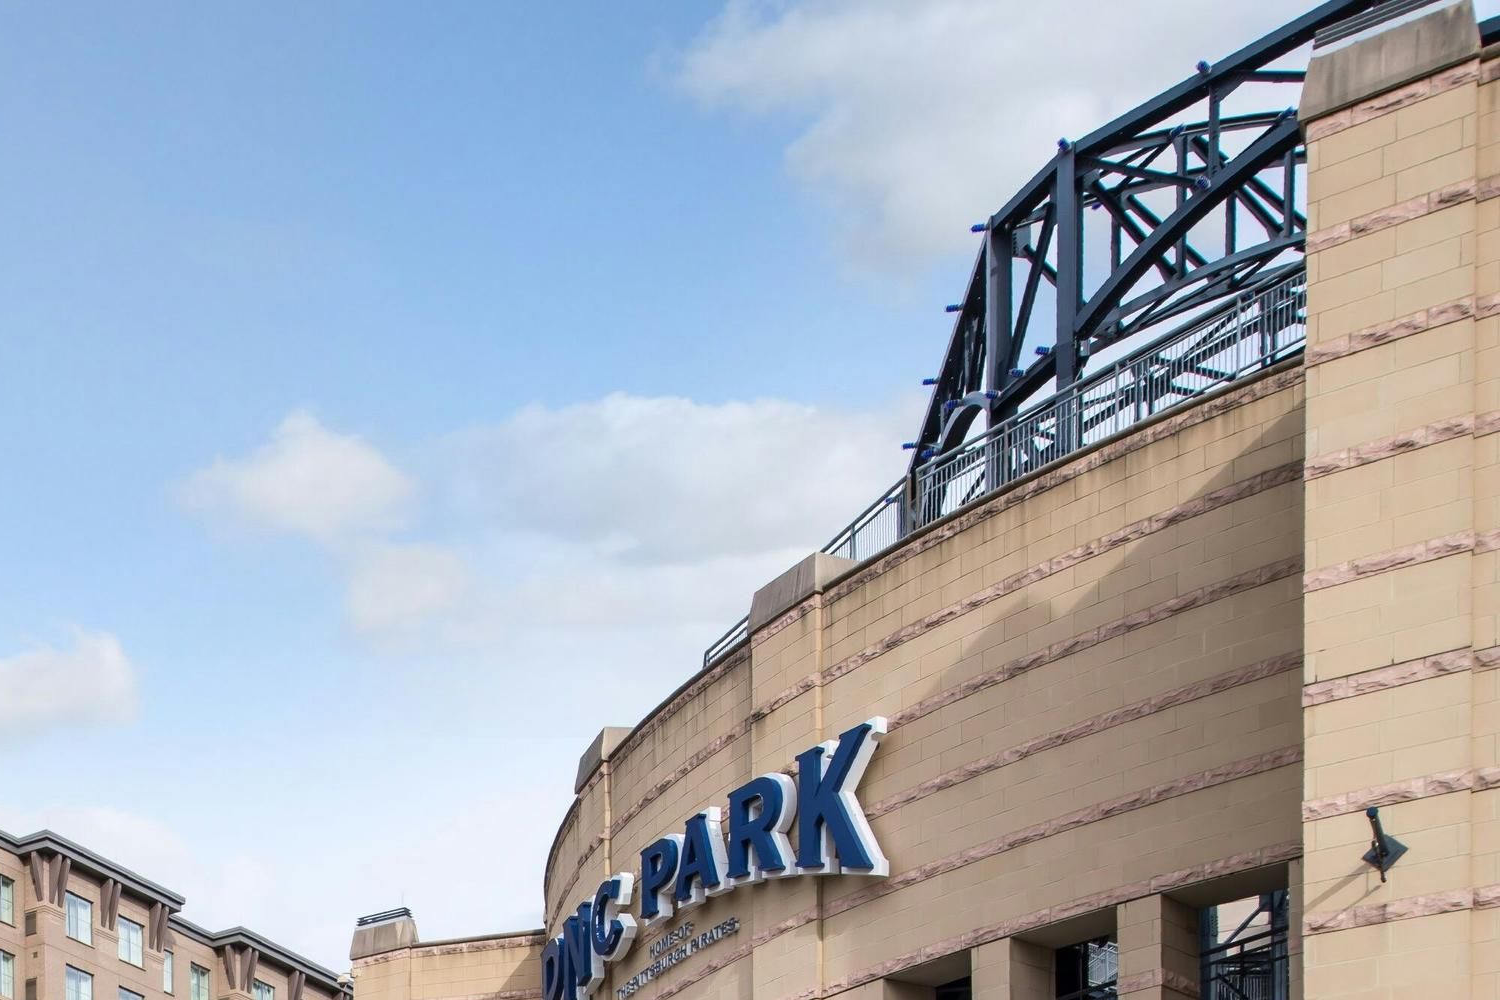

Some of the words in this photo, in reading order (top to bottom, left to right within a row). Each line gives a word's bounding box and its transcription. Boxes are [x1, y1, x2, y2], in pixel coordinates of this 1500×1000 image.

[640, 717, 888, 923] PARK
[631, 943, 691, 991] PITTSBURGH
[690, 917, 741, 953] PIRATES
[649, 930, 678, 958] HOME
[678, 921, 695, 939] OF
